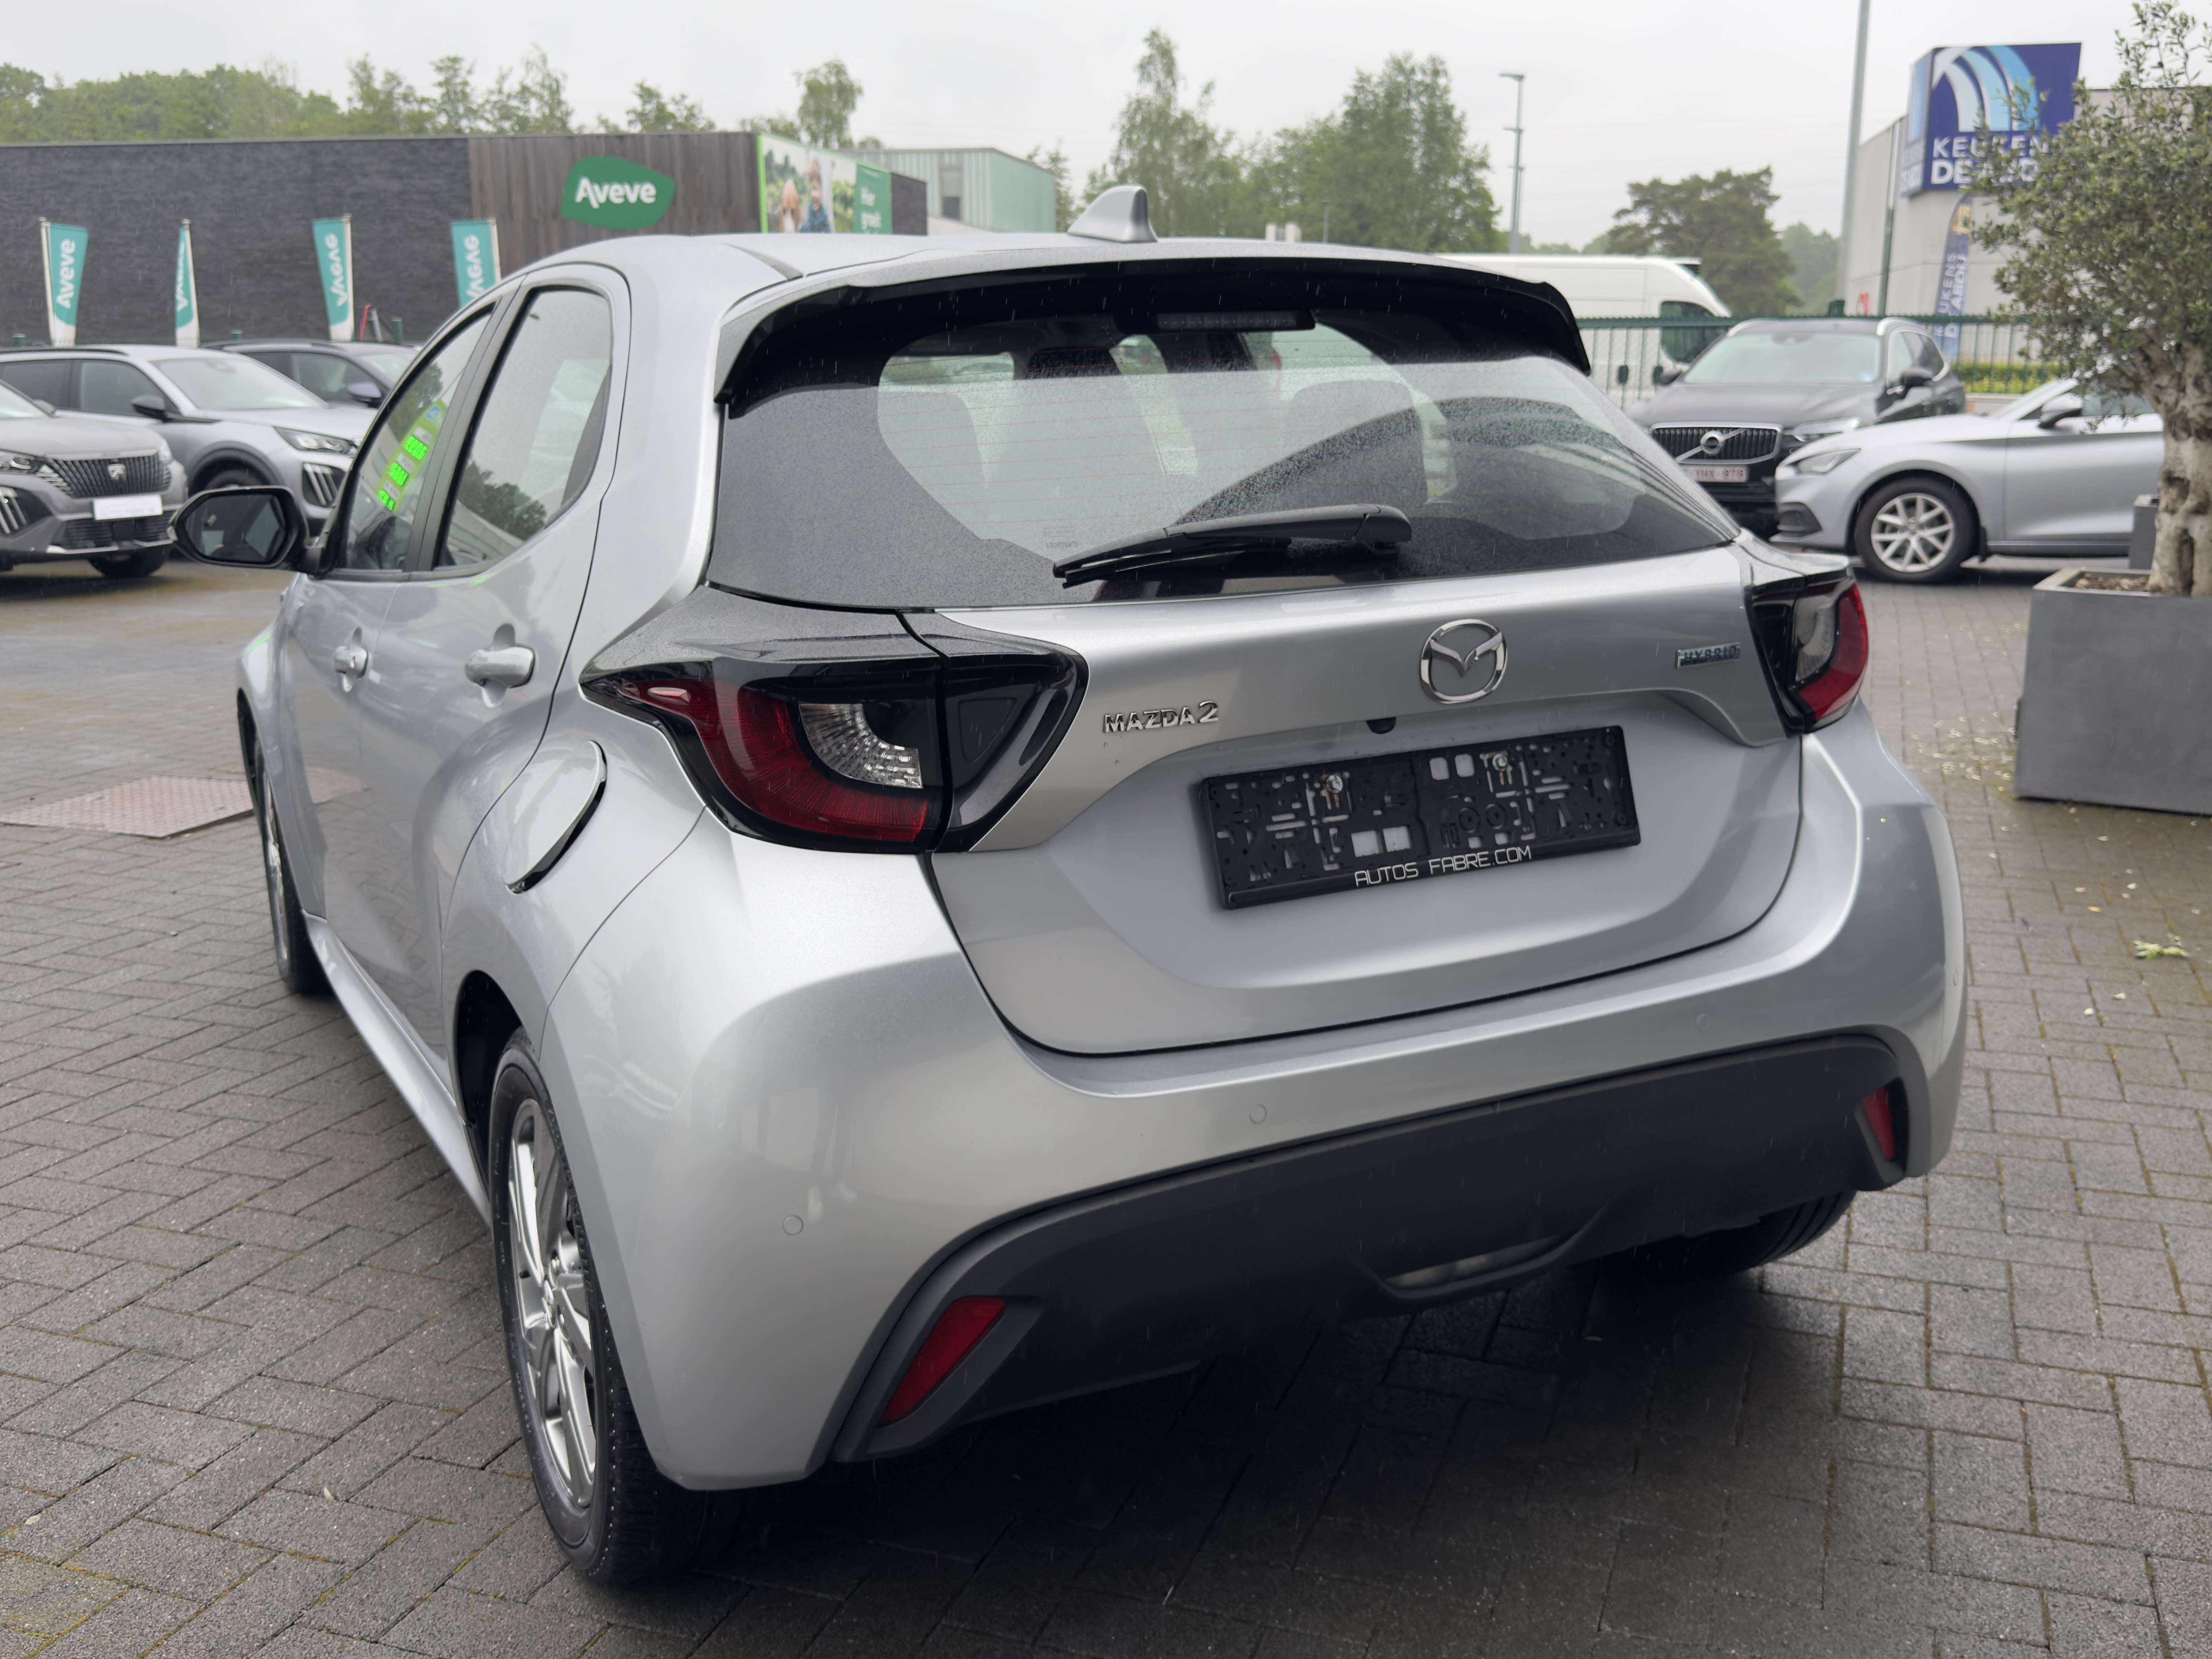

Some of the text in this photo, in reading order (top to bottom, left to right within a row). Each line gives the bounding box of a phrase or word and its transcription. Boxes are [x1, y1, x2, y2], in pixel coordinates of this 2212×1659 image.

[1933, 136, 2049, 158] KEUKEN
[575, 175, 657, 209] Aveve
[56, 239, 75, 308] Aveve
[1934, 252, 1958, 337] KUKENS
[1684, 645, 1738, 664] HYBRID
[1354, 845, 1532, 887] AUTOS FABRE.COM
